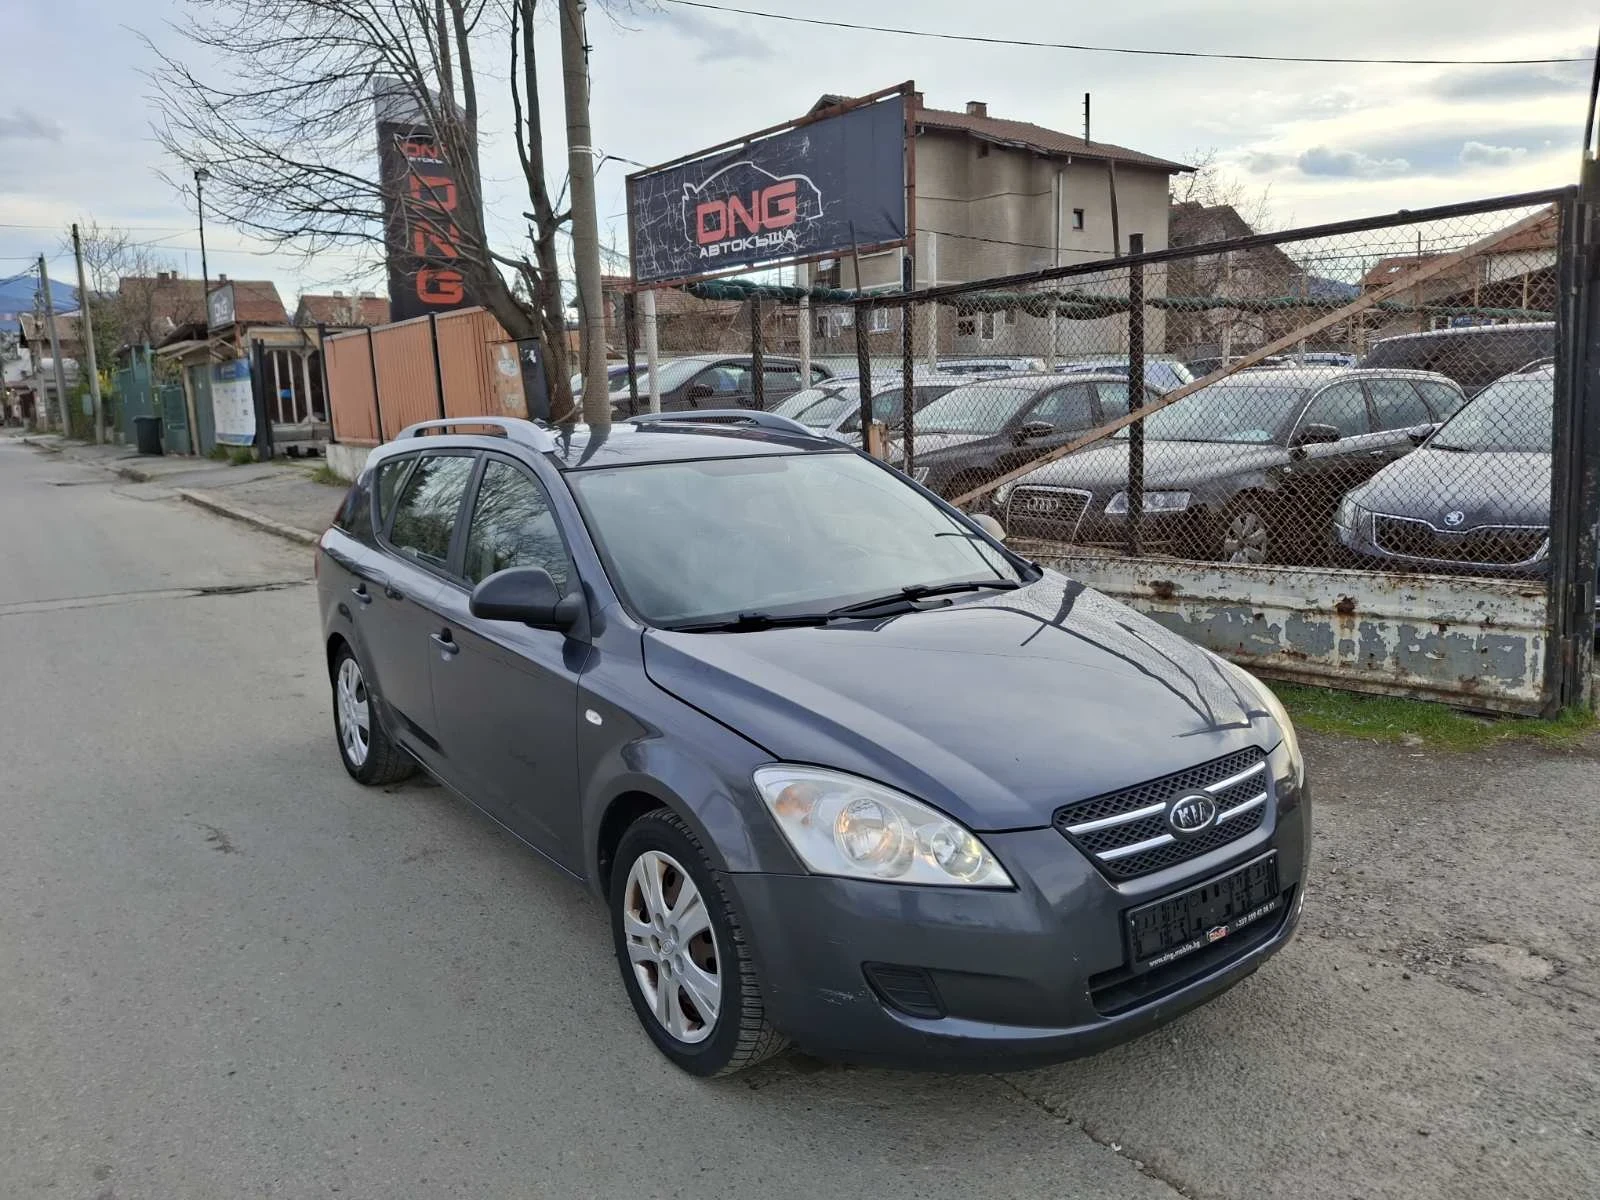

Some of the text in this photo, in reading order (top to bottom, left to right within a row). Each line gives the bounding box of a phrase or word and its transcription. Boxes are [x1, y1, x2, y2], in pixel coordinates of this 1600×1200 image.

[402, 142, 448, 158] DN
[697, 181, 798, 245] DNG
[1177, 801, 1206, 827] KIA
